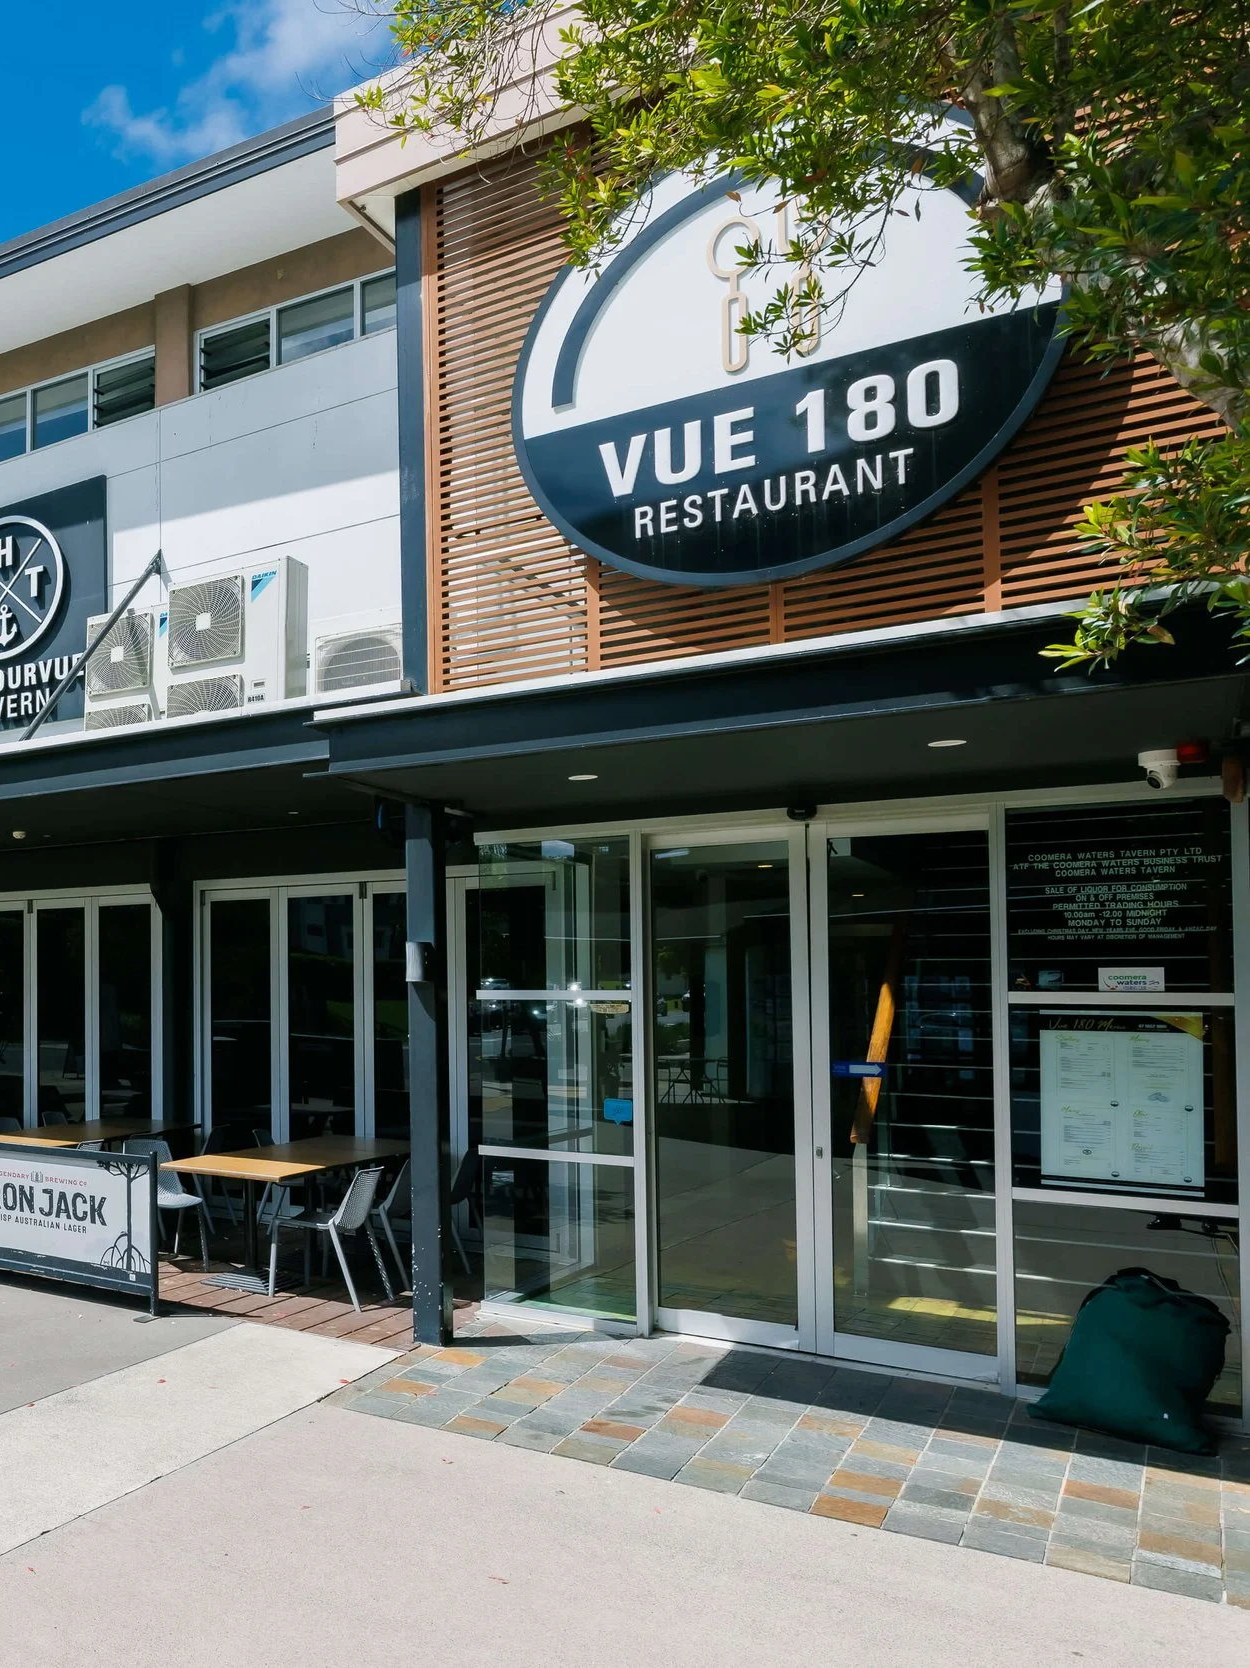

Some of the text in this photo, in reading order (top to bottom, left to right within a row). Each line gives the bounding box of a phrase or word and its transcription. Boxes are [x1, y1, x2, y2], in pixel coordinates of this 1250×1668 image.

[598, 358, 960, 498] VUE 180
[633, 447, 915, 539] RESTAURANT
[251, 570, 278, 580] DAIKIN
[24, 564, 45, 599] T
[1028, 847, 1202, 861] COOMERA WATERS TAVERN PTY LTD
[1033, 862, 1050, 870] THE
[1053, 861, 1097, 869] COOMERA
[1101, 859, 1139, 867] WATERS
[1144, 857, 1187, 865] BUSINESS
[1193, 855, 1222, 863] TRUST
[1055, 866, 1175, 877] COOMERA WATERS TAVERN
[1067, 886, 1078, 894] OF
[1080, 885, 1108, 893] LIQUOR
[1111, 884, 1127, 892] FOR
[1131, 883, 1187, 892] CONSUMPTION
[1116, 893, 1154, 901] PREMISES
[1052, 900, 1179, 910] PERMITTED TRADING HOURS
[1126, 909, 1167, 917] MIDNIGHT
[1068, 919, 1105, 927] MONDAY
[1126, 918, 1161, 926] SUNDAY
[1073, 1017, 1095, 1030] 180
[44, 1176, 78, 1186] BREWING
[38, 1188, 107, 1226] JACK
[14, 1216, 60, 1230] AUSTRALIAN
[63, 1225, 87, 1234] LAGER
